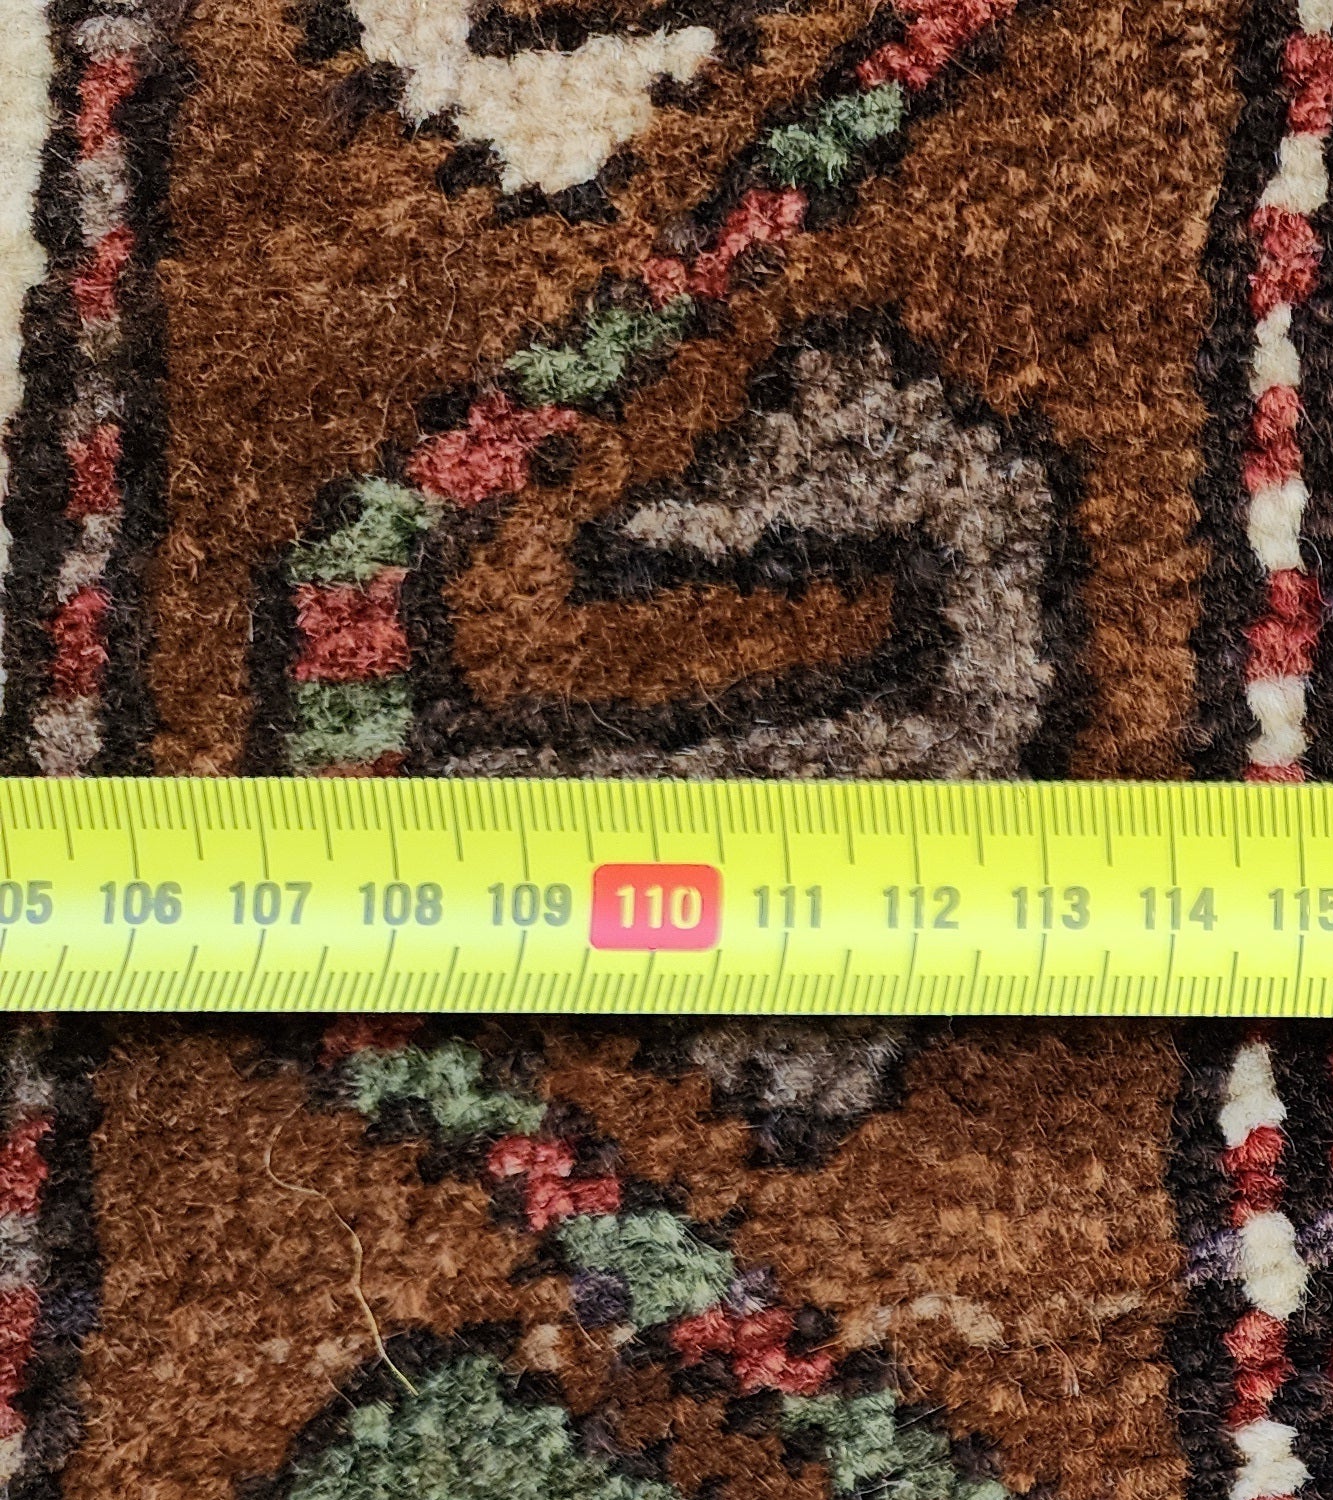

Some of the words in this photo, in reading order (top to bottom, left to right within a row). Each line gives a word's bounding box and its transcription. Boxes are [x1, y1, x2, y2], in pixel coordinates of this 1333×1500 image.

[0, 880, 53, 925] 05
[99, 881, 182, 925] 106
[228, 881, 312, 925] 107
[358, 881, 443, 926] 108
[487, 882, 572, 927] 109
[616, 886, 702, 929] 110
[752, 885, 822, 928] 111
[882, 885, 960, 929] 112
[1011, 886, 1090, 930] 113
[1139, 887, 1218, 931] 114
